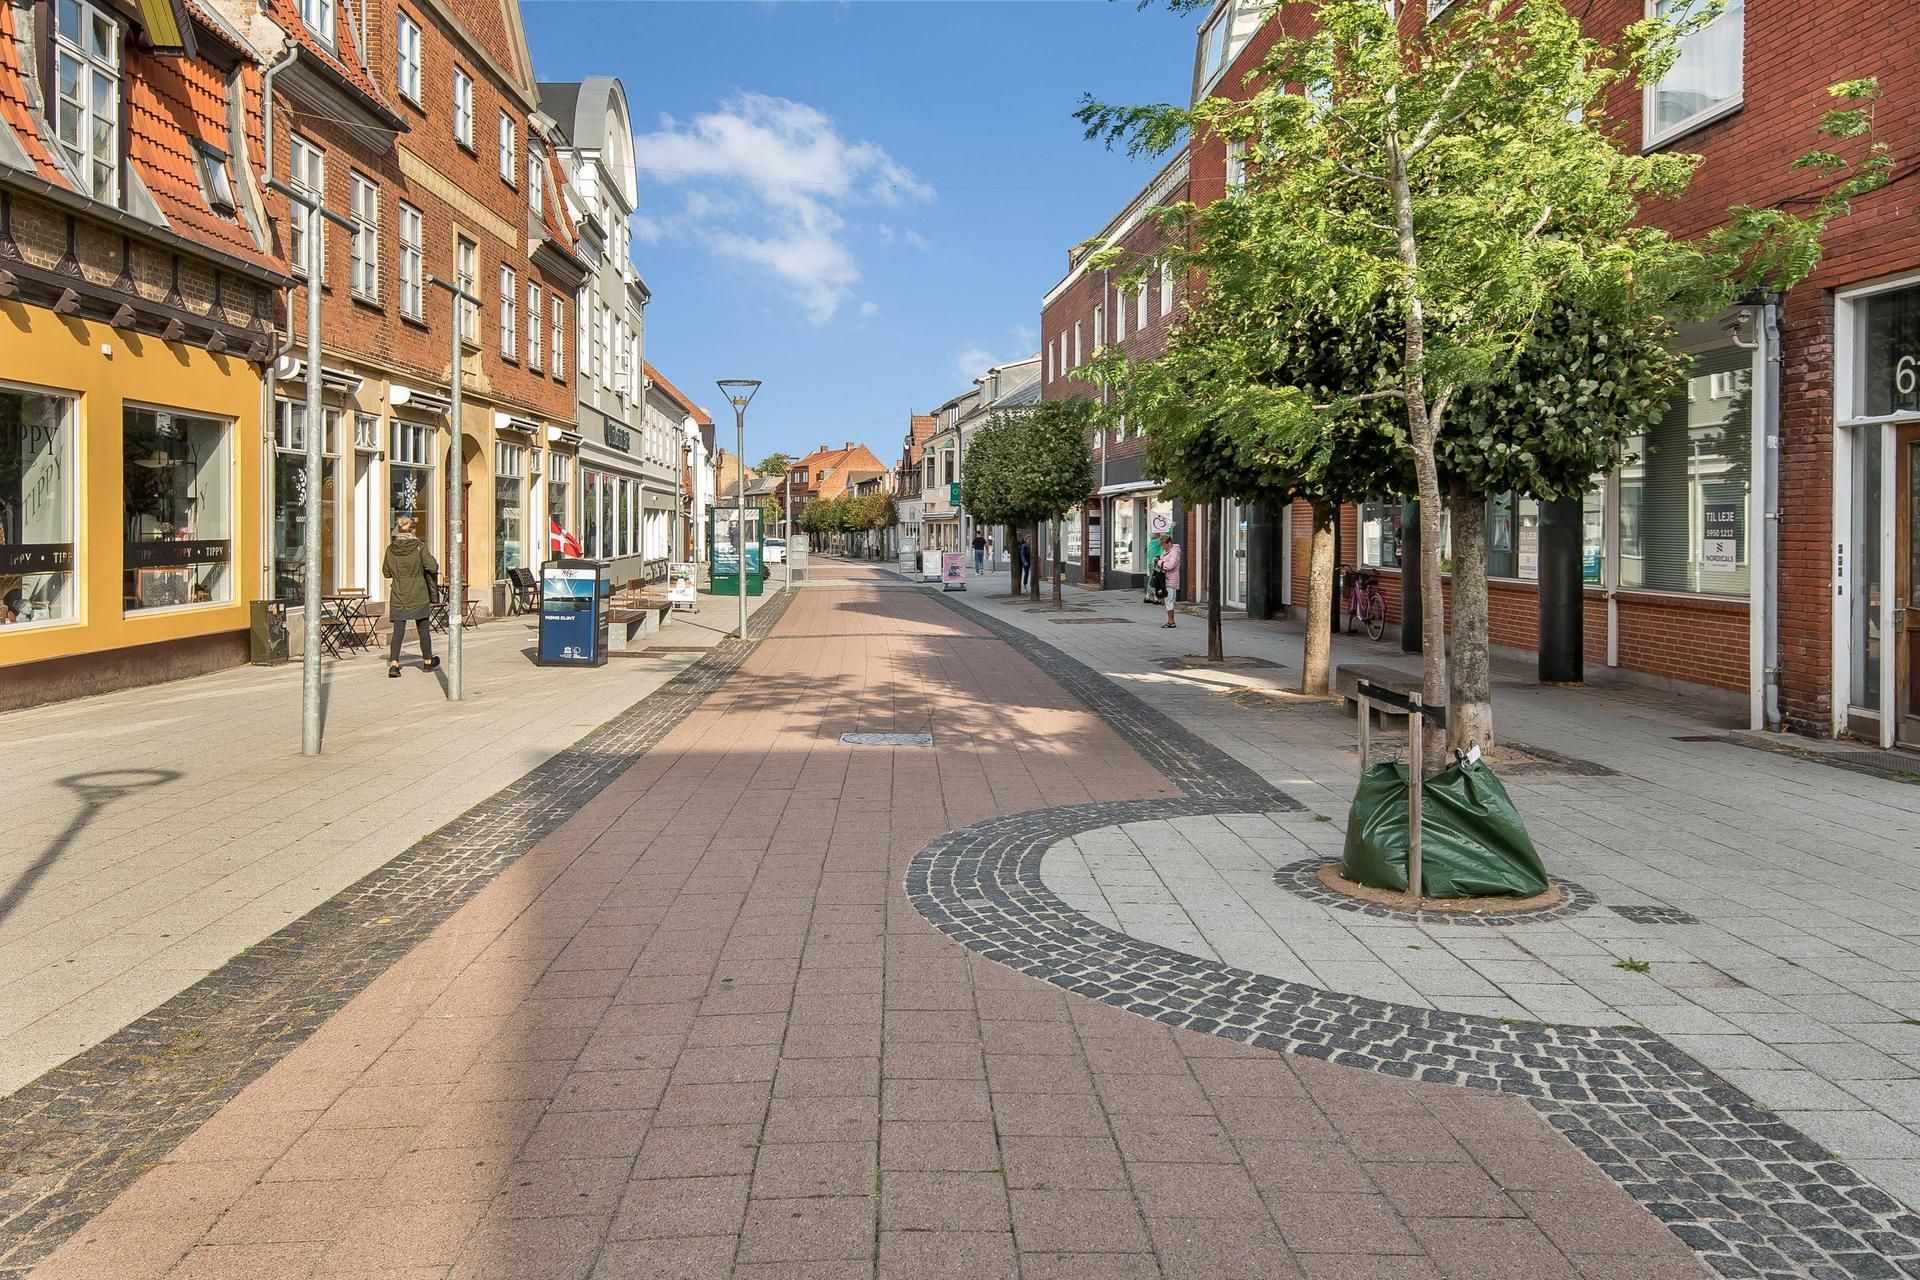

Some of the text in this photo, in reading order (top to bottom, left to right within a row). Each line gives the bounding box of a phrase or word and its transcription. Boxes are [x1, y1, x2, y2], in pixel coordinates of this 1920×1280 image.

[1895, 354, 1920, 394] 6
[1706, 511, 1735, 522] TIL LEJE
[205, 546, 224, 557] TIPPY
